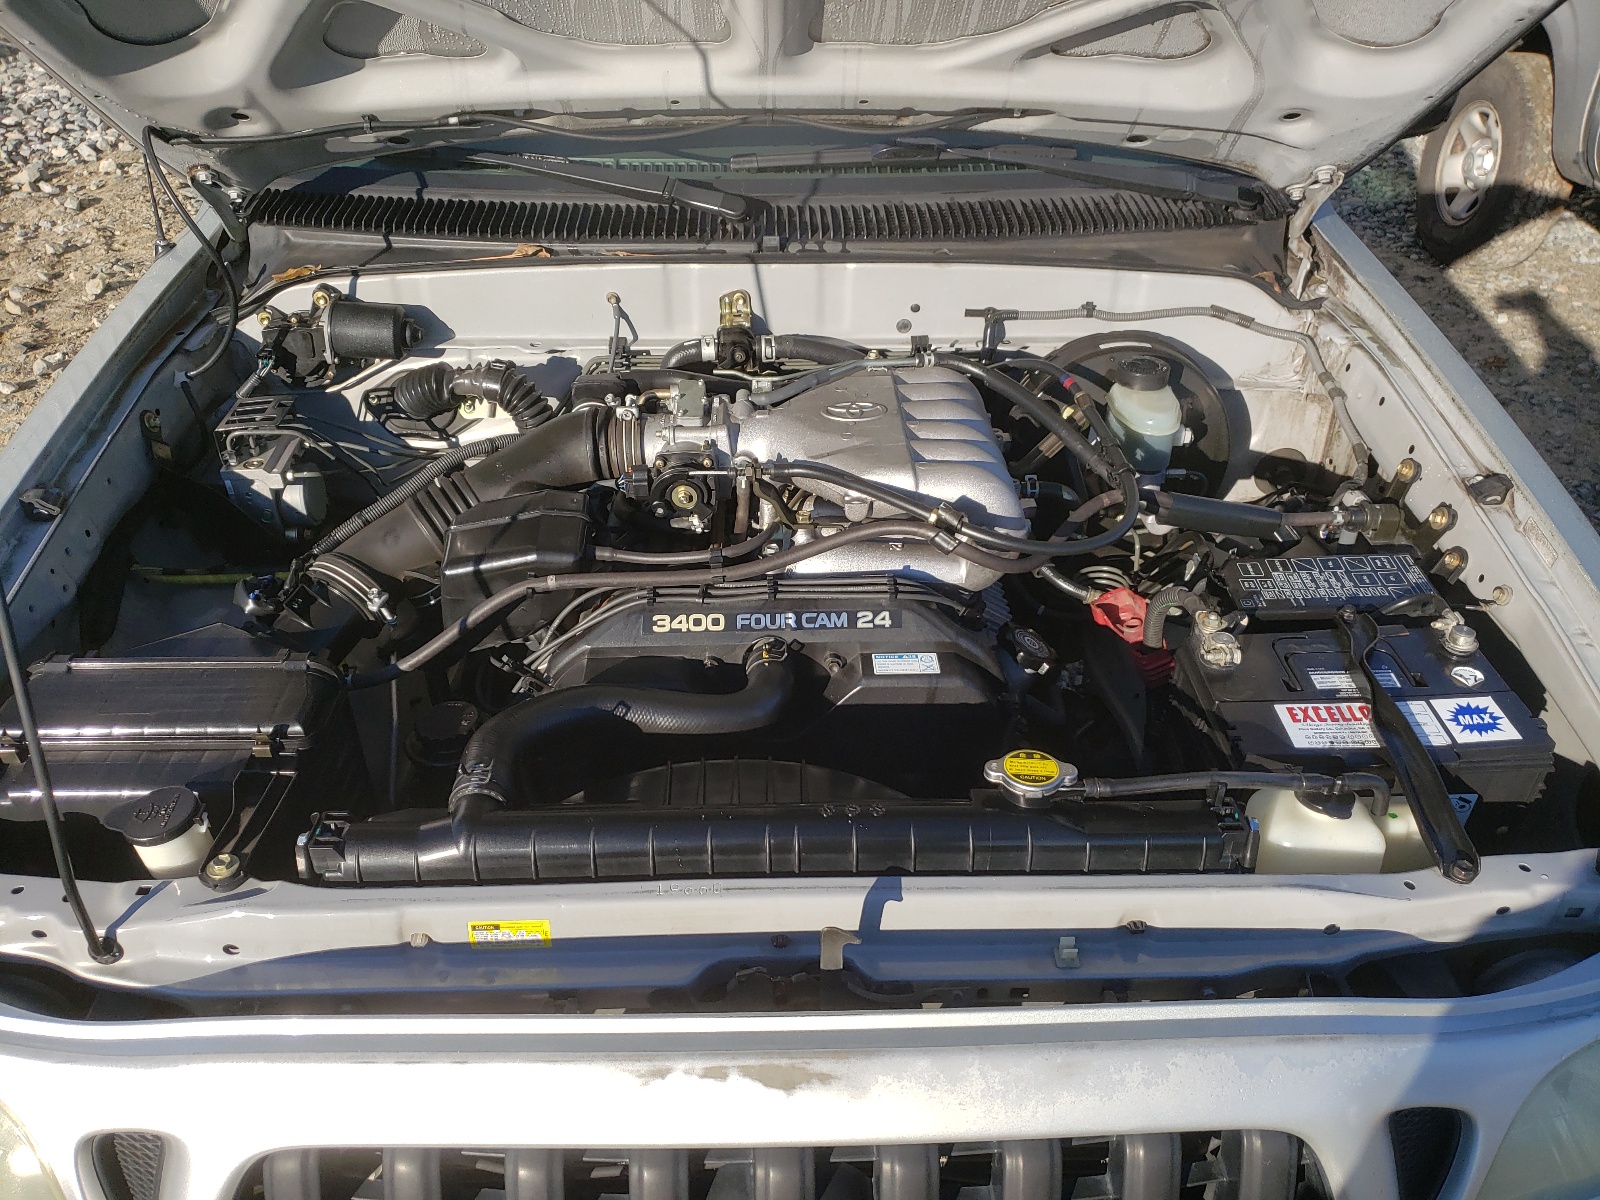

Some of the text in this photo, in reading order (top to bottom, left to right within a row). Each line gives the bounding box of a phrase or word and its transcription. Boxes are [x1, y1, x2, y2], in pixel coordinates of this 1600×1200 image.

[652, 610, 892, 632] 3400 FOUR CAM 24
[1457, 713, 1494, 725] MAX
